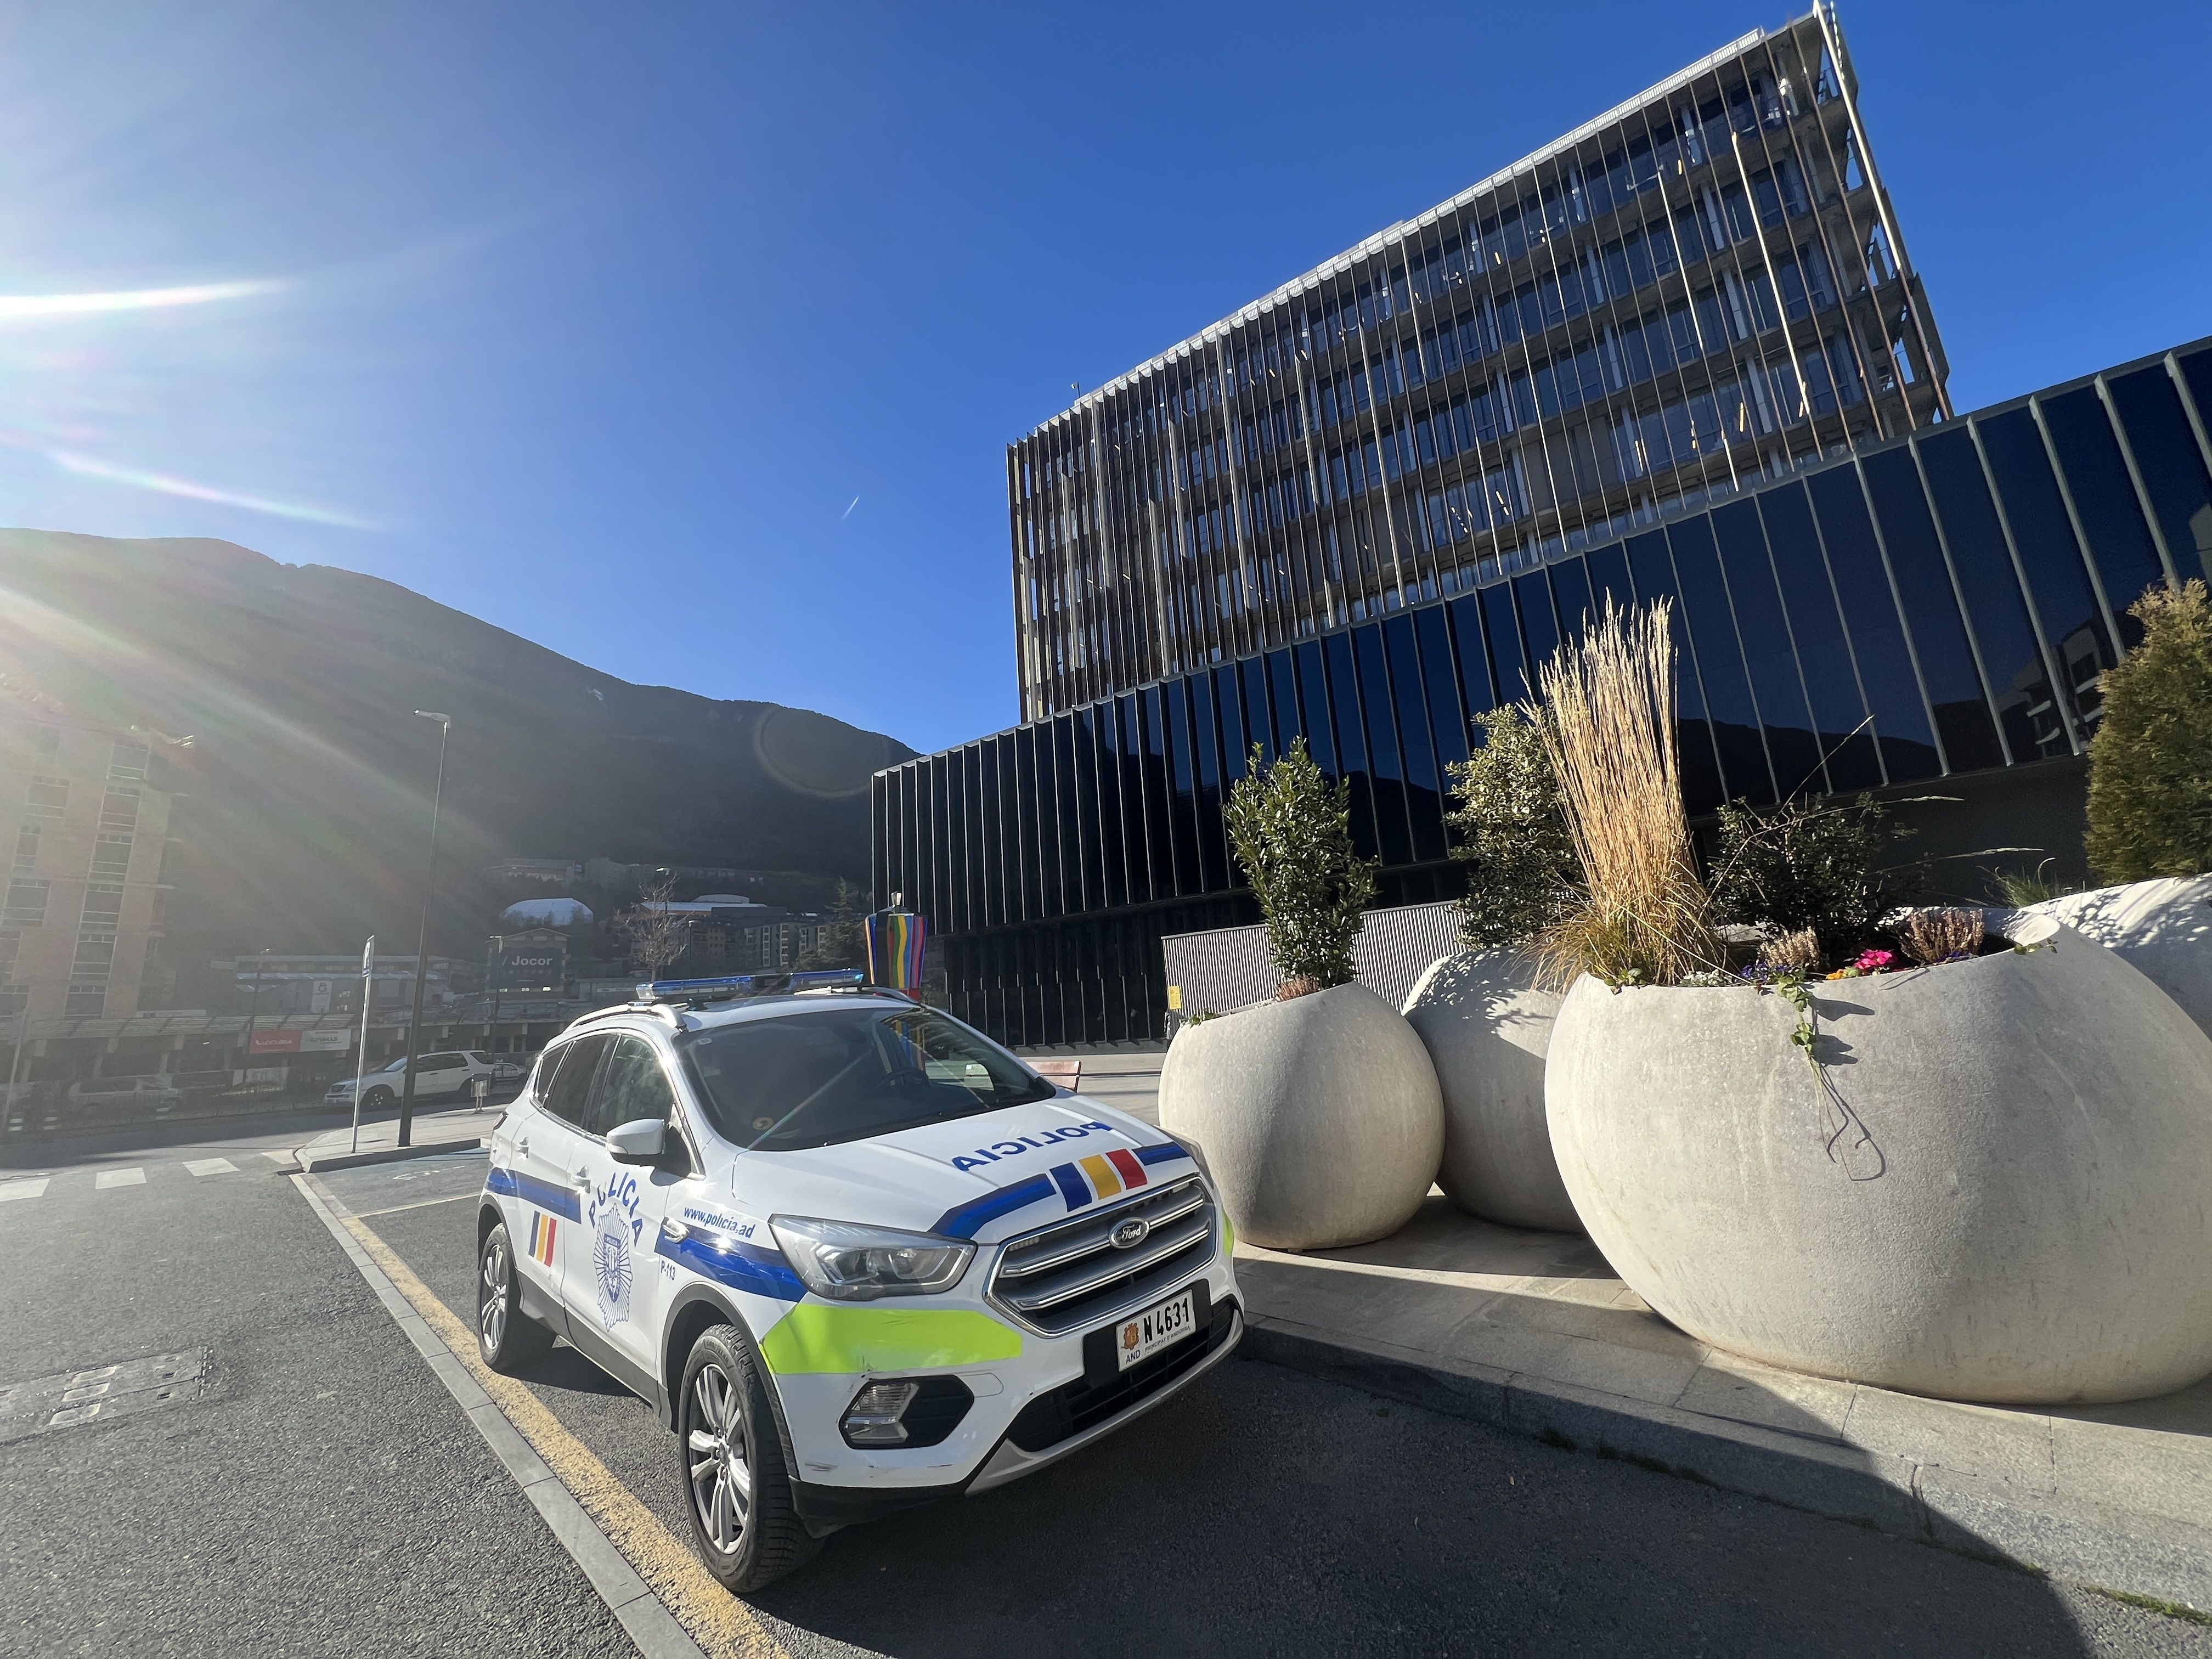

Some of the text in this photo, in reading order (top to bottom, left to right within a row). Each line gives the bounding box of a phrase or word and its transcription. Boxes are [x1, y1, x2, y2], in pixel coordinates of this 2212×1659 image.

[511, 956, 553, 966] Jocor
[589, 1172, 643, 1248] POLICIA
[684, 1206, 756, 1239] www.policia.ad
[1122, 1224, 1141, 1240] Ford
[661, 1260, 676, 1281] P-113
[1143, 1297, 1189, 1344] N 4631
[1126, 1350, 1141, 1364] AND
